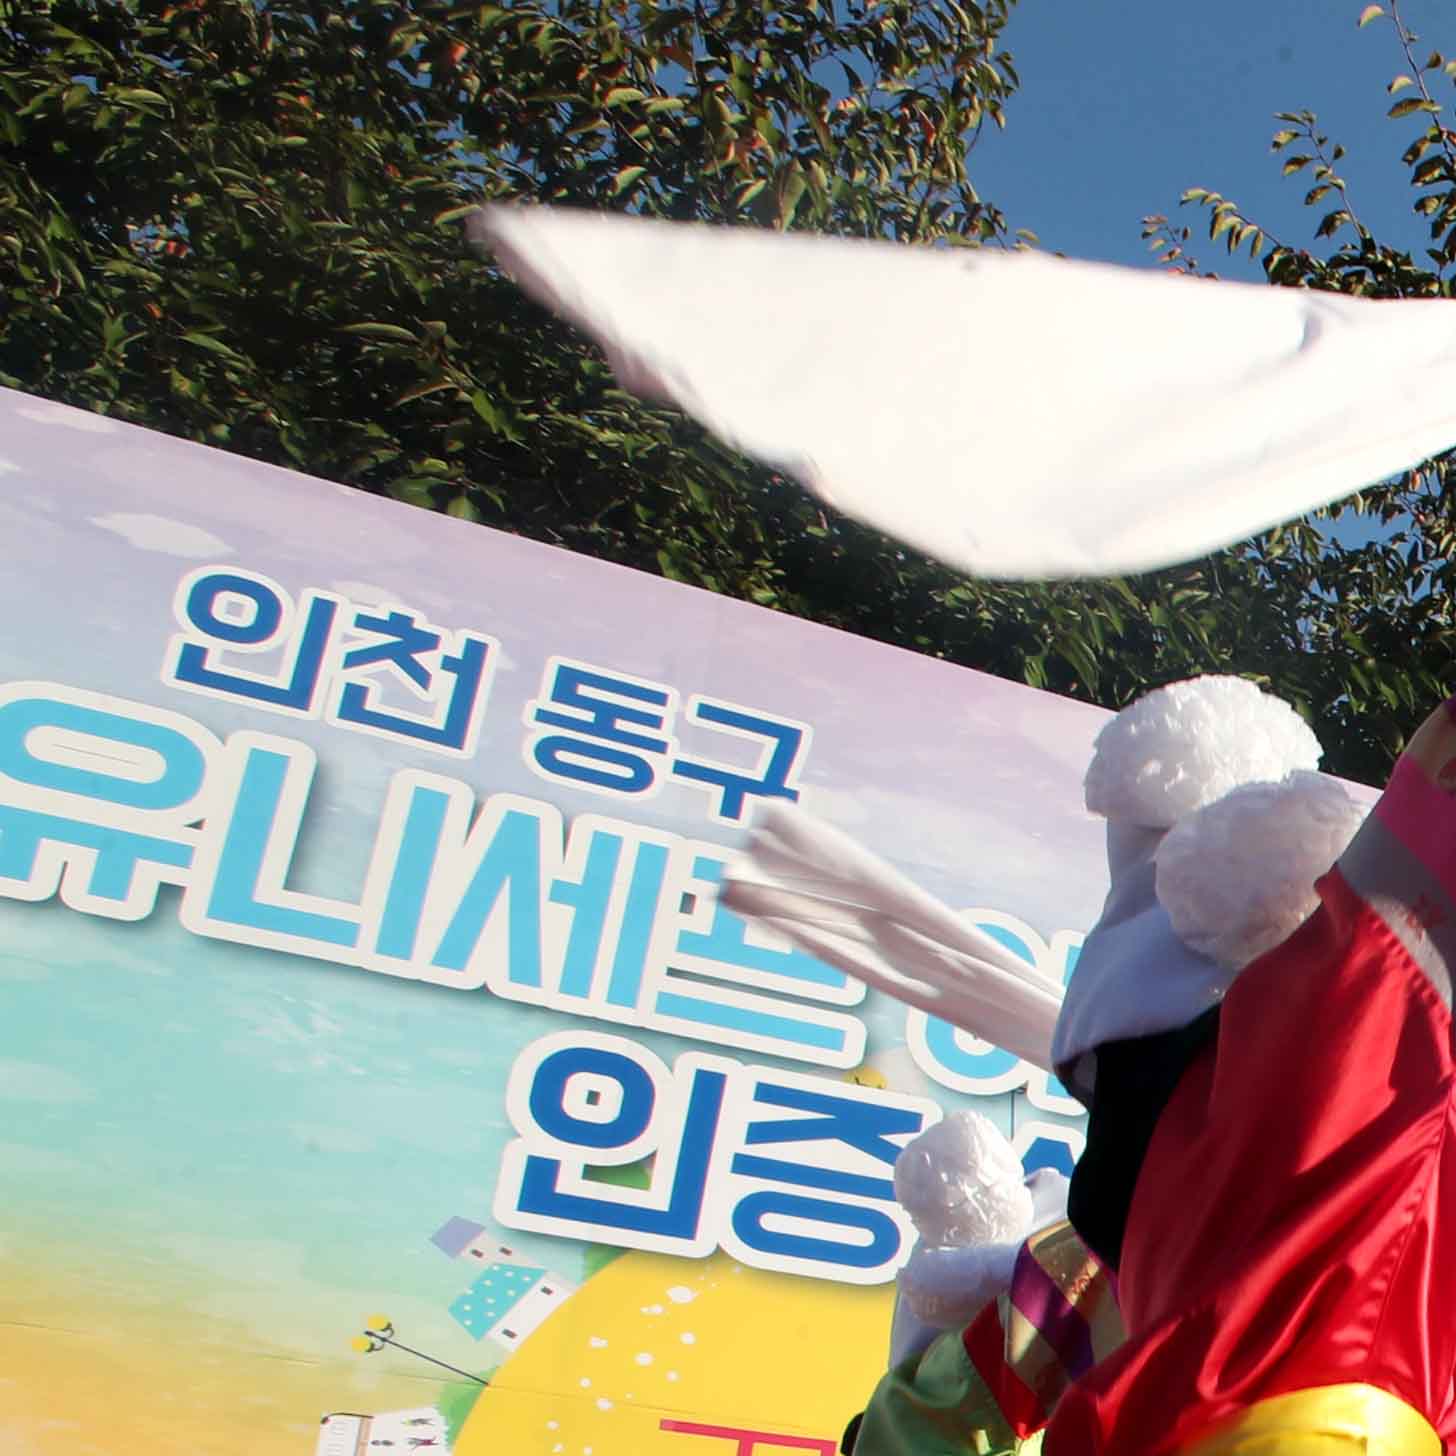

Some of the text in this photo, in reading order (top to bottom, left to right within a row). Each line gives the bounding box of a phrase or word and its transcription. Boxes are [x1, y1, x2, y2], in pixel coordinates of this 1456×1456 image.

[174, 574, 804, 821] 인천 동구
[0, 697, 849, 1054] 유니세프
[515, 1045, 924, 1268] 인증
